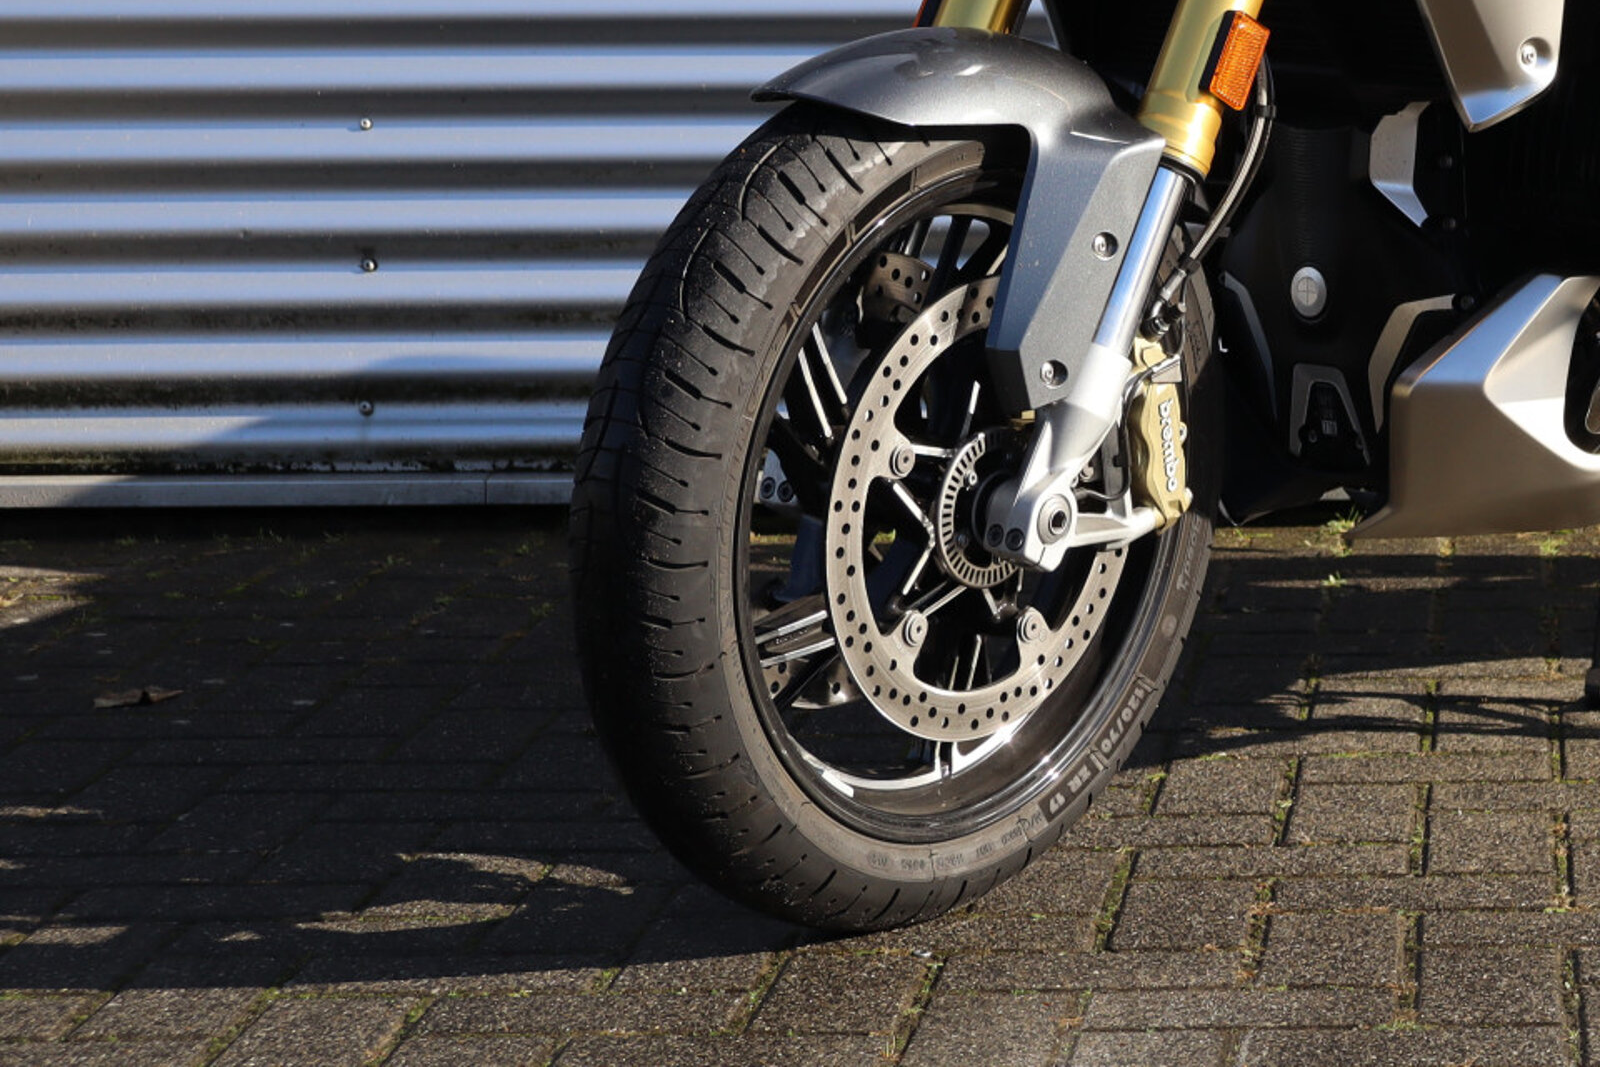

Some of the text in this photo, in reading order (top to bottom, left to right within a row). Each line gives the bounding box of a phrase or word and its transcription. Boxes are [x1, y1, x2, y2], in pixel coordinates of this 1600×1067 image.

[1158, 397, 1179, 493] brembo
[1100, 686, 1146, 755] 120/70
[1050, 791, 1067, 815] 17
[1067, 765, 1092, 794] ZR
